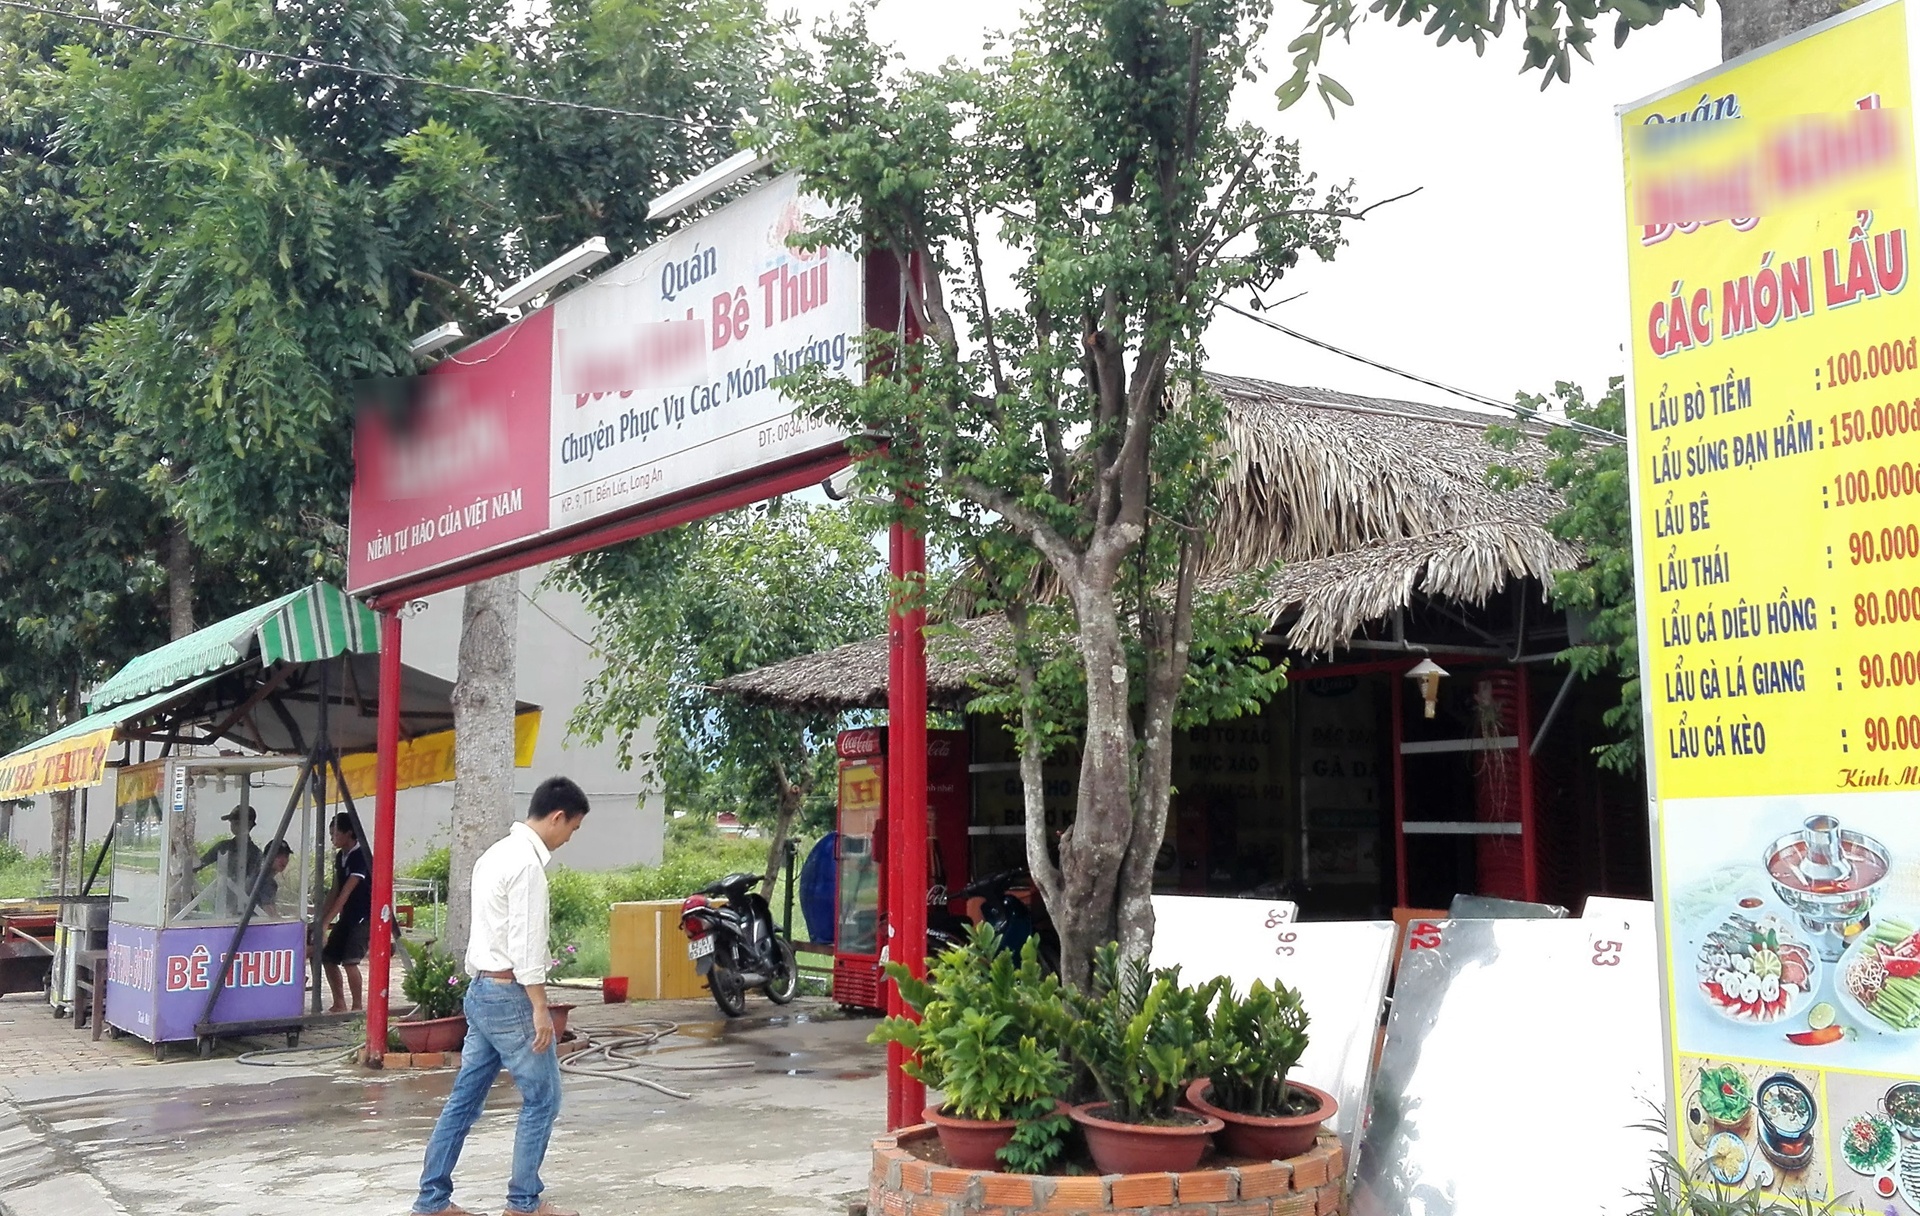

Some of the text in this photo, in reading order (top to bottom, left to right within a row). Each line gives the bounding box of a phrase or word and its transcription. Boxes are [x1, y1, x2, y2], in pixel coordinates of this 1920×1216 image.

[661, 242, 717, 302] Quán
[712, 245, 828, 351] Bê Thui
[1649, 209, 1909, 359] CÁC MÓN LẨU
[561, 420, 614, 464] Chuyên
[620, 408, 659, 443] Phục
[663, 394, 685, 430] Vụ
[726, 359, 768, 403] Món
[1650, 383, 1678, 431] LẨU
[1684, 382, 1705, 423] BÒ
[1710, 367, 1751, 415] TIỀM
[1653, 436, 1681, 484] LẨU
[1687, 436, 1728, 477] SÚNG
[1733, 430, 1768, 471] ĐẠN
[1773, 409, 1813, 458] HẦM
[596, 481, 611, 502] Bến
[631, 473, 650, 492] Long
[651, 467, 663, 484] An
[367, 488, 523, 562] NIỀM TỰ HÀO CỦA VIỆT NAM
[1655, 490, 1684, 538] LẨU
[1690, 491, 1710, 531] BÊ
[1659, 545, 1687, 592] LẨU
[1692, 545, 1730, 587] THÁI
[1662, 599, 1691, 647] LẨU
[1696, 602, 1717, 642] CÁ
[1722, 598, 1761, 640] DIÊU
[1767, 587, 1817, 635] HỒNG
[1665, 655, 1695, 703] LẨU
[1700, 659, 1721, 700] GÀ
[1725, 656, 1747, 697] LÁ
[1752, 658, 1805, 695] GIANG
[1859, 650, 1920, 689] 90.00
[1669, 711, 1698, 759] LẨU
[1704, 714, 1726, 757] CÁ
[1730, 714, 1766, 755] KÈO
[1410, 922, 1441, 950] 42
[1592, 940, 1623, 966] 53
[166, 944, 294, 992] BÊ THUI
